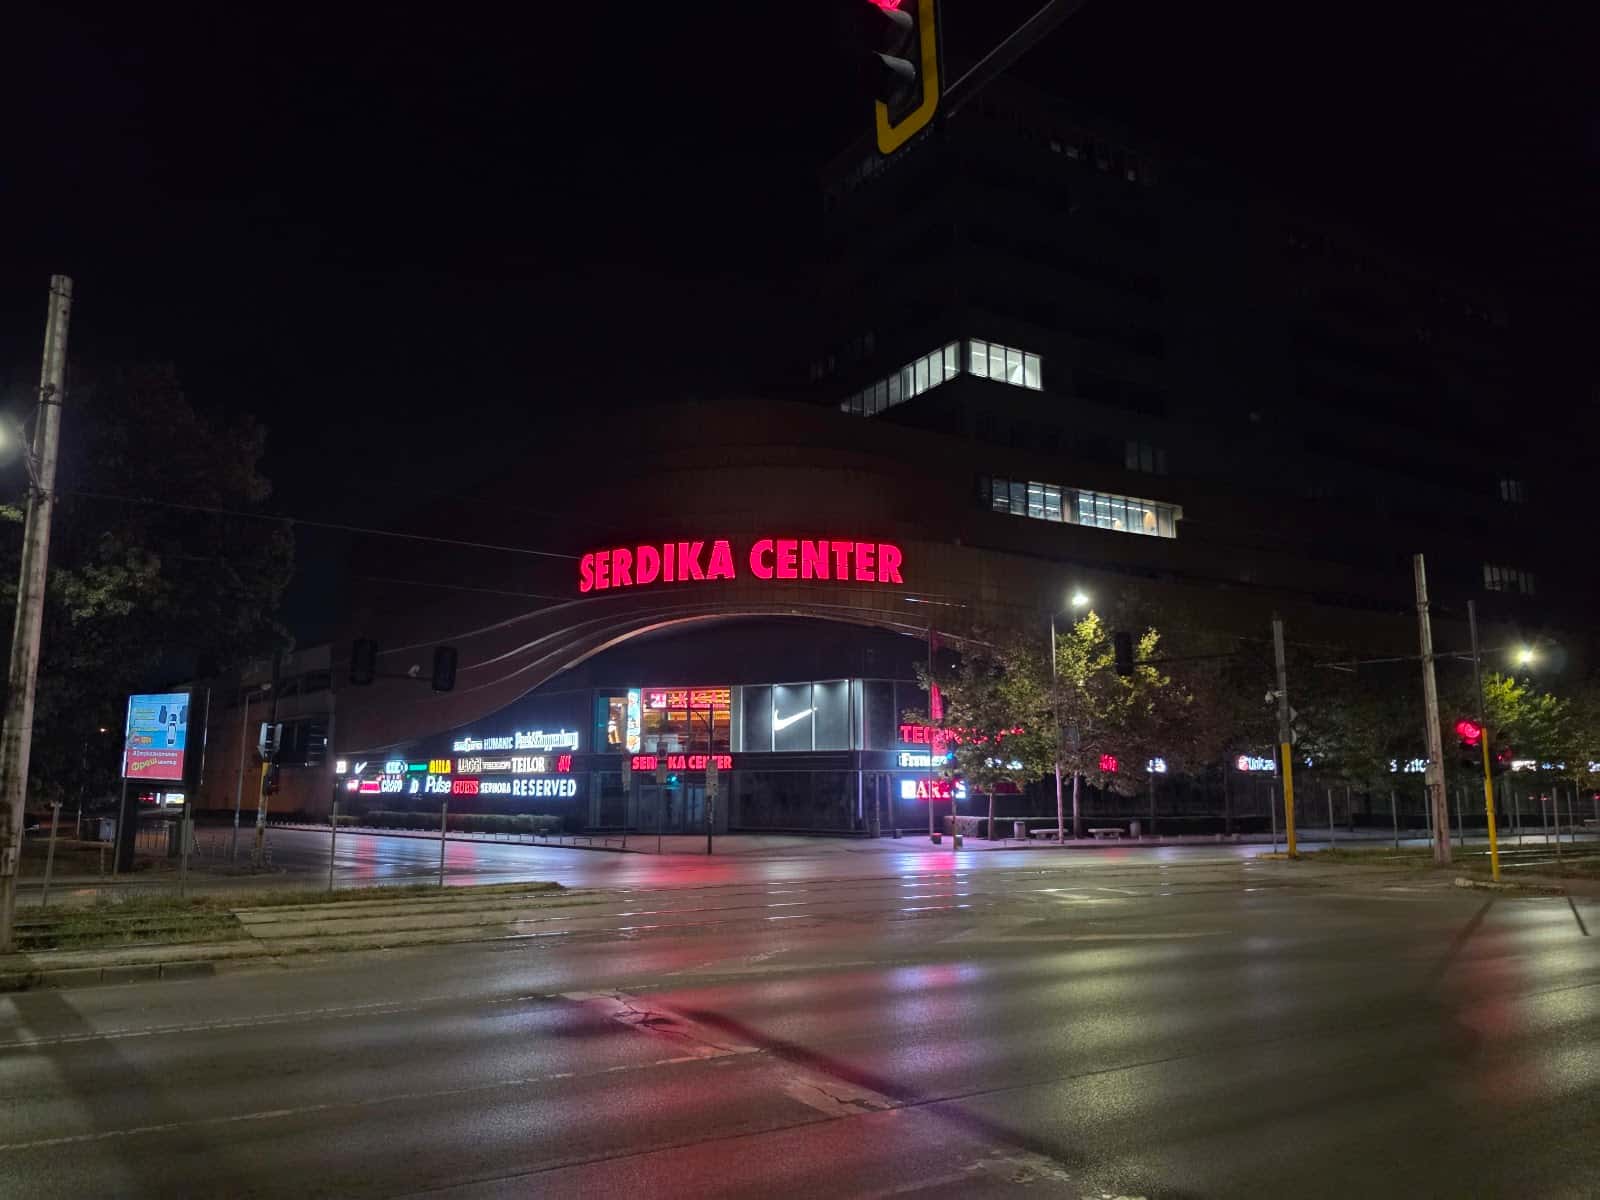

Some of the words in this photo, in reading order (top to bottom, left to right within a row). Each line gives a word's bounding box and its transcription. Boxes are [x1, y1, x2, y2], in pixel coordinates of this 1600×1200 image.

[580, 540, 735, 592] SERDIKA
[750, 540, 903, 583] CENTER
[484, 738, 513, 750] HUMANIC
[511, 757, 545, 773] TEILOR
[425, 775, 451, 793] Pulse
[454, 781, 478, 794] GUESS
[480, 782, 511, 794] SEPHORA
[513, 779, 576, 796] RESERVED
